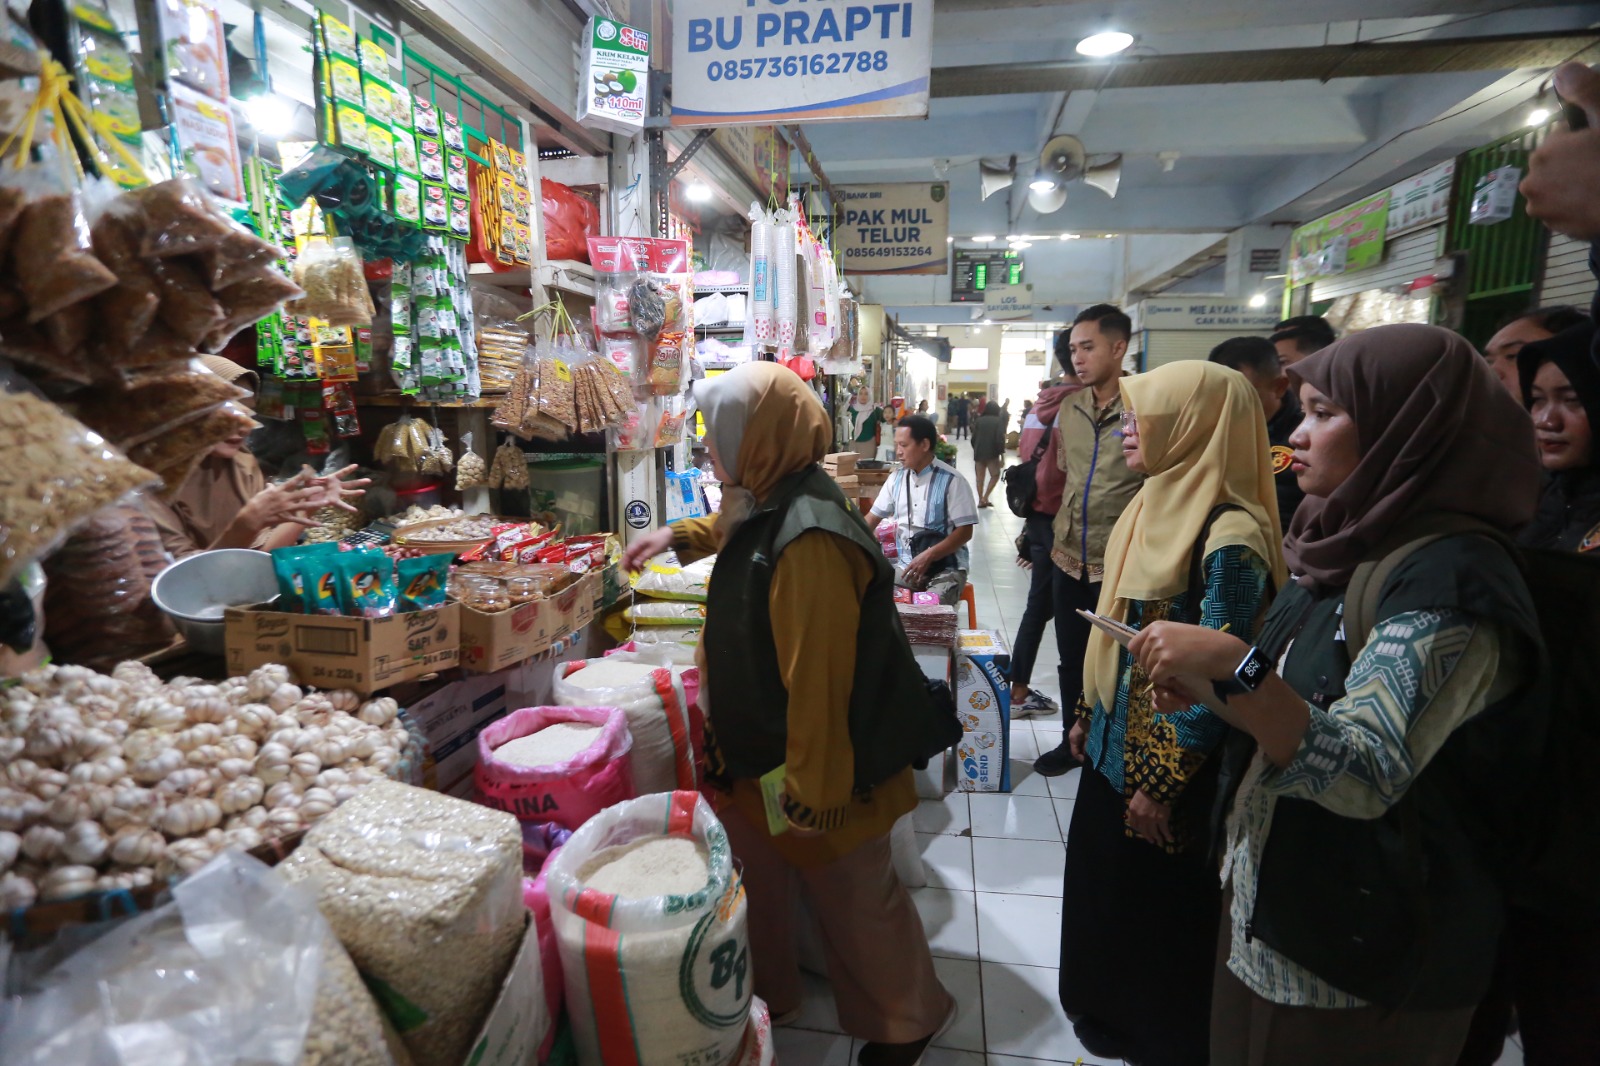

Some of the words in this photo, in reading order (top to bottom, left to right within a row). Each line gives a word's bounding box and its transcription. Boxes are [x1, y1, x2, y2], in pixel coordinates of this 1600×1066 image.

[688, 15, 744, 52] BU
[756, 3, 912, 48] PRAPTI
[596, 50, 616, 59] KRIM
[616, 53, 645, 63] KELAPA
[706, 50, 888, 82] 085736162788
[608, 97, 643, 110] 110ml
[846, 210, 885, 226] PAK
[891, 208, 933, 225] MUL
[857, 227, 921, 244] TELUR
[846, 246, 933, 258] 085649153264
[255, 642, 275, 653] SAPI
[408, 636, 431, 651] SAPI
[313, 666, 325, 677] 24
[336, 668, 354, 679] 220
[985, 661, 1008, 692] SEND
[979, 754, 989, 783] SEND
